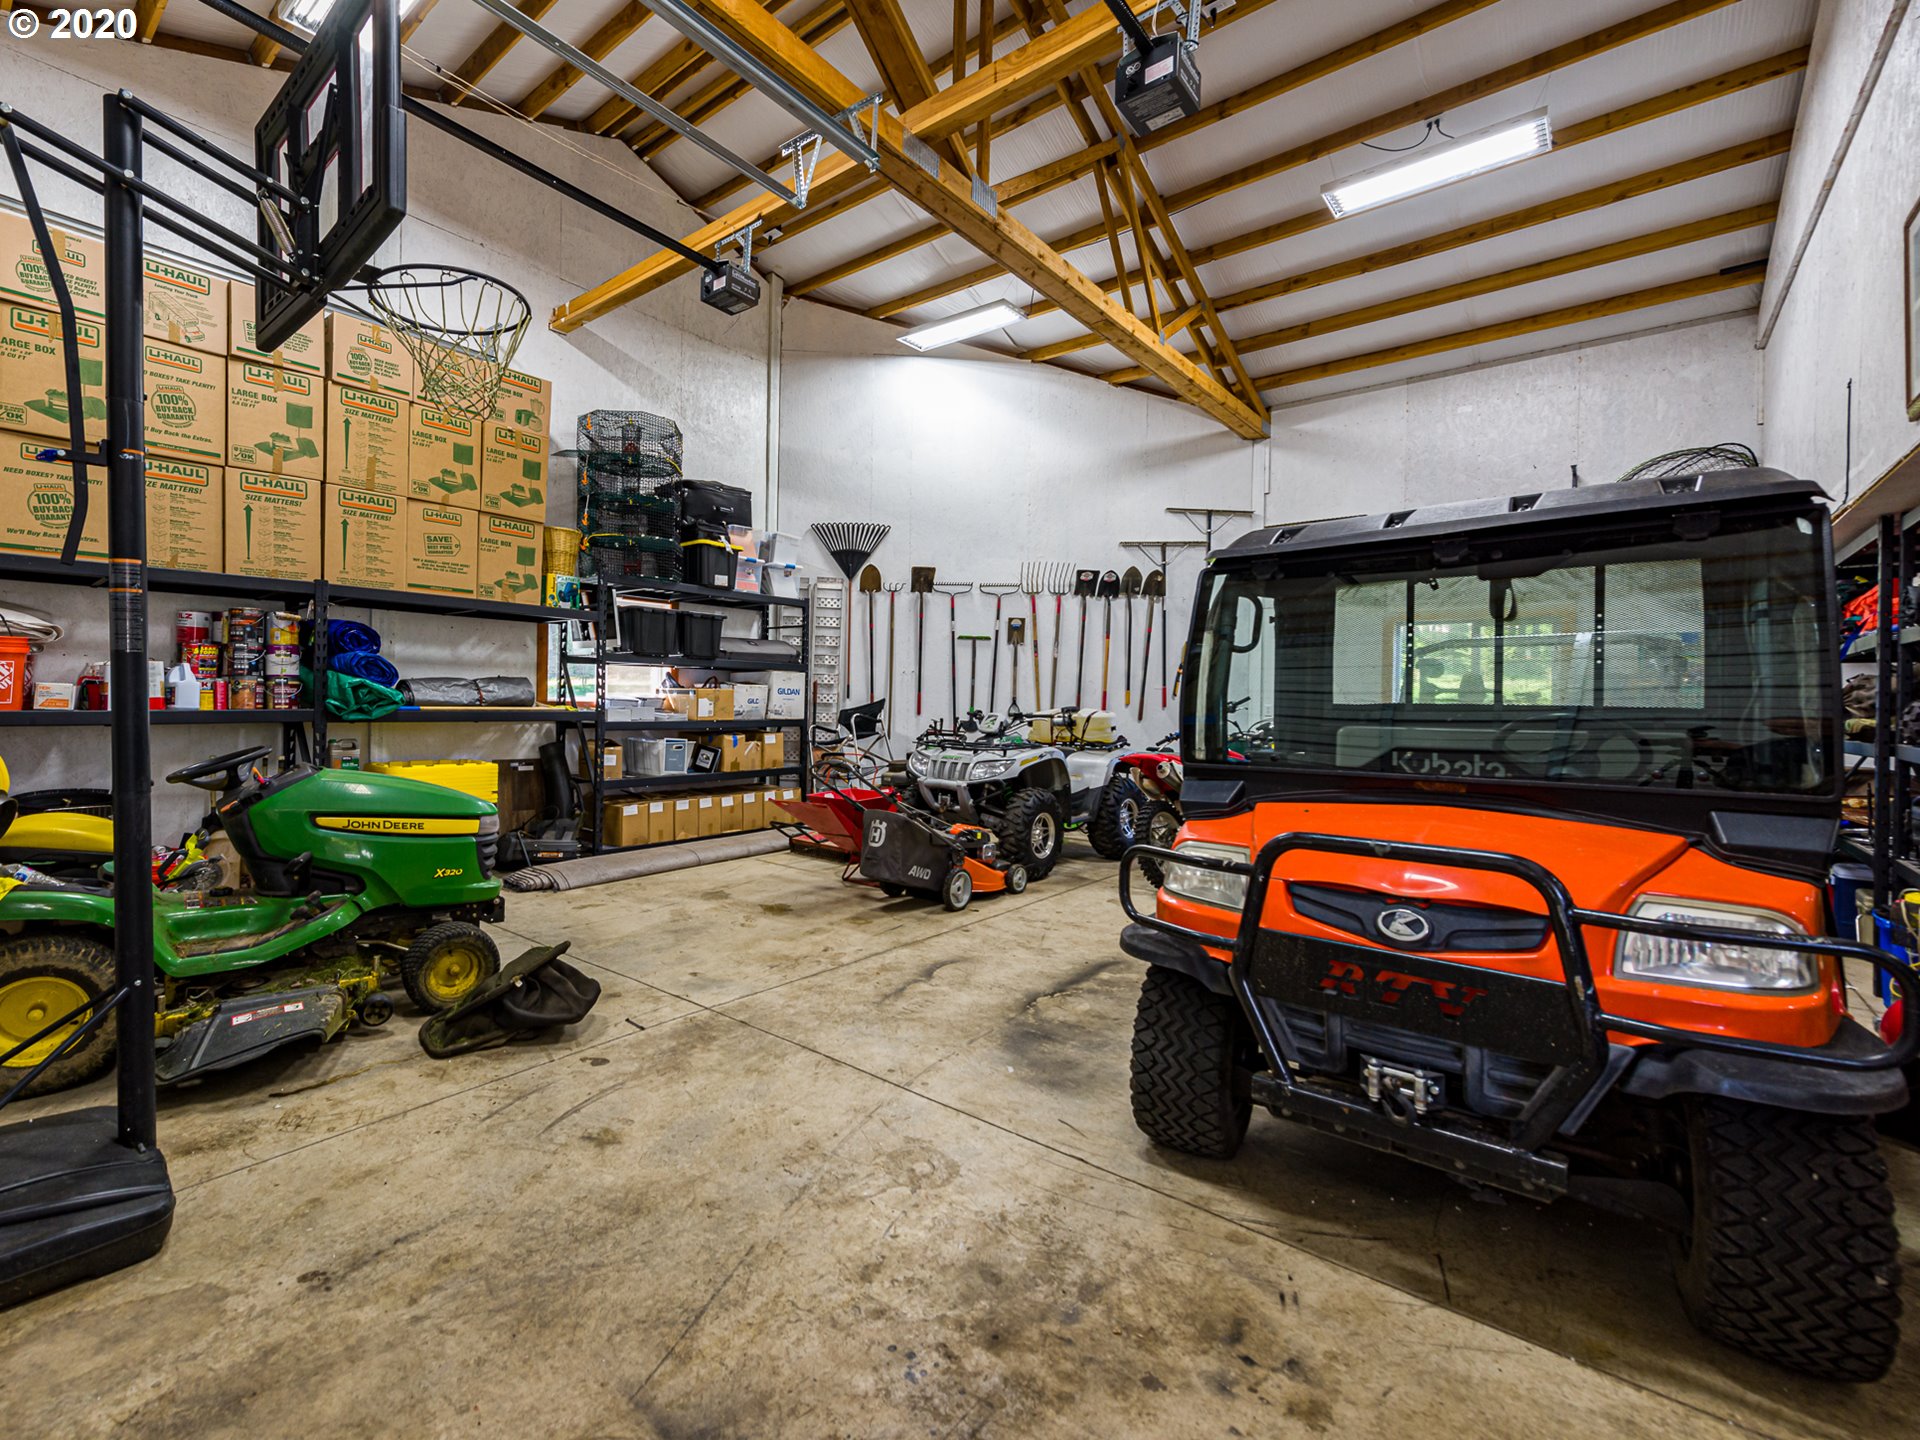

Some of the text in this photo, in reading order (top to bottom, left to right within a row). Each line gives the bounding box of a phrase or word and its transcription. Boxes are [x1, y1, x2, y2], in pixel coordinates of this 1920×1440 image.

[20, 262, 48, 275] 100%
[145, 261, 206, 288] U-HAUL
[20, 271, 50, 281] BUY-BAC
[20, 278, 51, 287] GUARANT
[76, 274, 98, 286] BOXES?
[74, 280, 98, 292] PLENTY!
[154, 283, 173, 292] Loading
[174, 287, 185, 295] Your
[0, 336, 57, 356] ARGE BOX
[359, 335, 390, 350] U-HUL
[148, 348, 199, 368] U-HAUL
[350, 352, 369, 362] 100%
[149, 370, 217, 391] BOXES? TAKE PLENTY!
[502, 371, 539, 388] U-HAUL
[157, 393, 189, 406] 100%
[231, 387, 259, 400] LARGE
[261, 393, 278, 404] BOX
[344, 390, 395, 411] U-HAUL
[6, 411, 24, 421] OK
[155, 404, 194, 415] BUY-BACK
[344, 407, 394, 425] SIZE MATTERS!
[156, 412, 196, 421] GUARANTEE
[425, 411, 469, 431] U-AUL
[150, 426, 163, 435] Buy
[163, 429, 180, 437] Back
[180, 432, 192, 440] the
[412, 430, 447, 444] LARGE BOX
[240, 452, 254, 461] OK
[486, 446, 518, 460] LARGE BOX
[3, 466, 24, 475] NEED
[25, 469, 54, 479] BOXES?
[56, 474, 73, 482] TAKE
[159, 482, 203, 495] MATTERS!
[244, 475, 304, 492] U-HAUL
[34, 493, 72, 505] 100%
[245, 494, 303, 508] SIZE MATTERS!
[342, 491, 393, 508] U-HAUL
[32, 505, 74, 514] BUY-BAC
[342, 509, 392, 522] SIZE MATTERS!
[425, 510, 460, 522] U-HAUL
[34, 513, 72, 521] GUARANT
[492, 519, 533, 534] U-HAUL
[6, 527, 100, 544] We'll Buy Back xtras.
[426, 535, 453, 543] SAVE!
[480, 537, 513, 548] LARGE BOX
[777, 687, 801, 696] GILDAN
[342, 818, 425, 831] JOHN DEERE
[433, 867, 464, 879] X320
[907, 865, 932, 880] AWD
